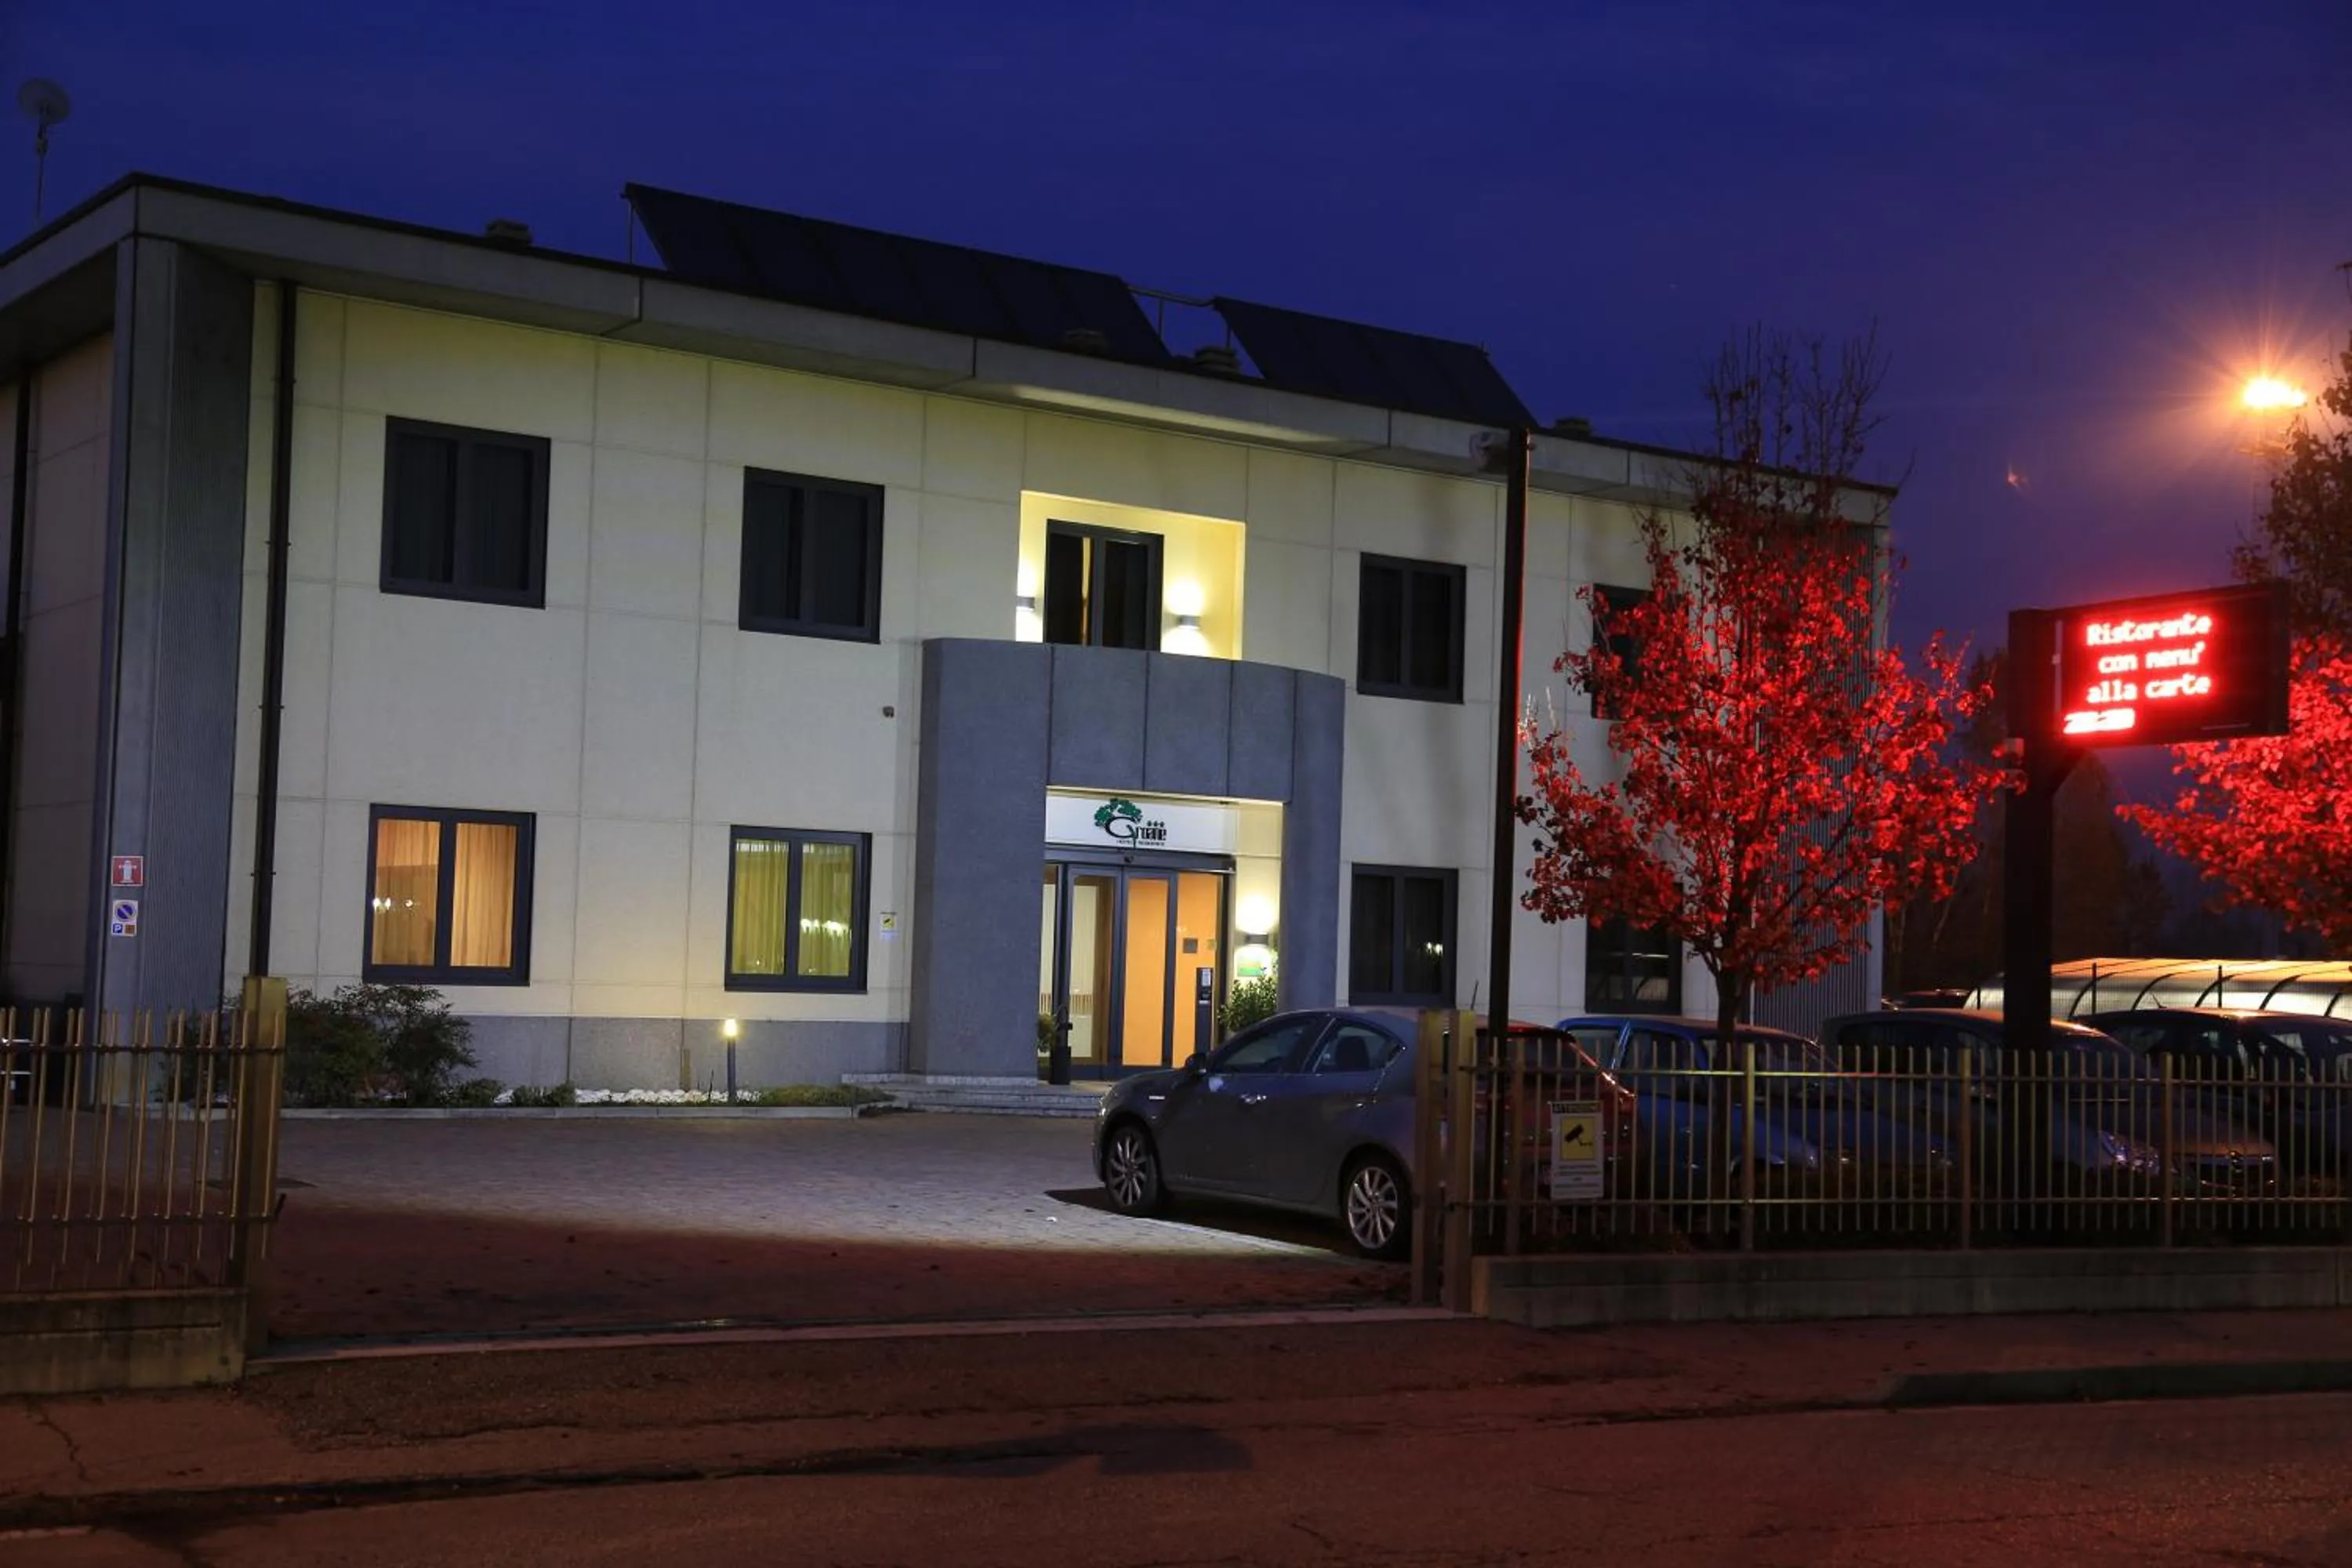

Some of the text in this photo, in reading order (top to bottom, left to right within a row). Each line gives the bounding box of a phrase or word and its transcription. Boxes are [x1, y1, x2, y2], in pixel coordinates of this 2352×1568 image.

[2087, 614, 2212, 645] Ristorante
[2099, 654, 2137, 673] con
[2087, 673, 2211, 702] alla carte
